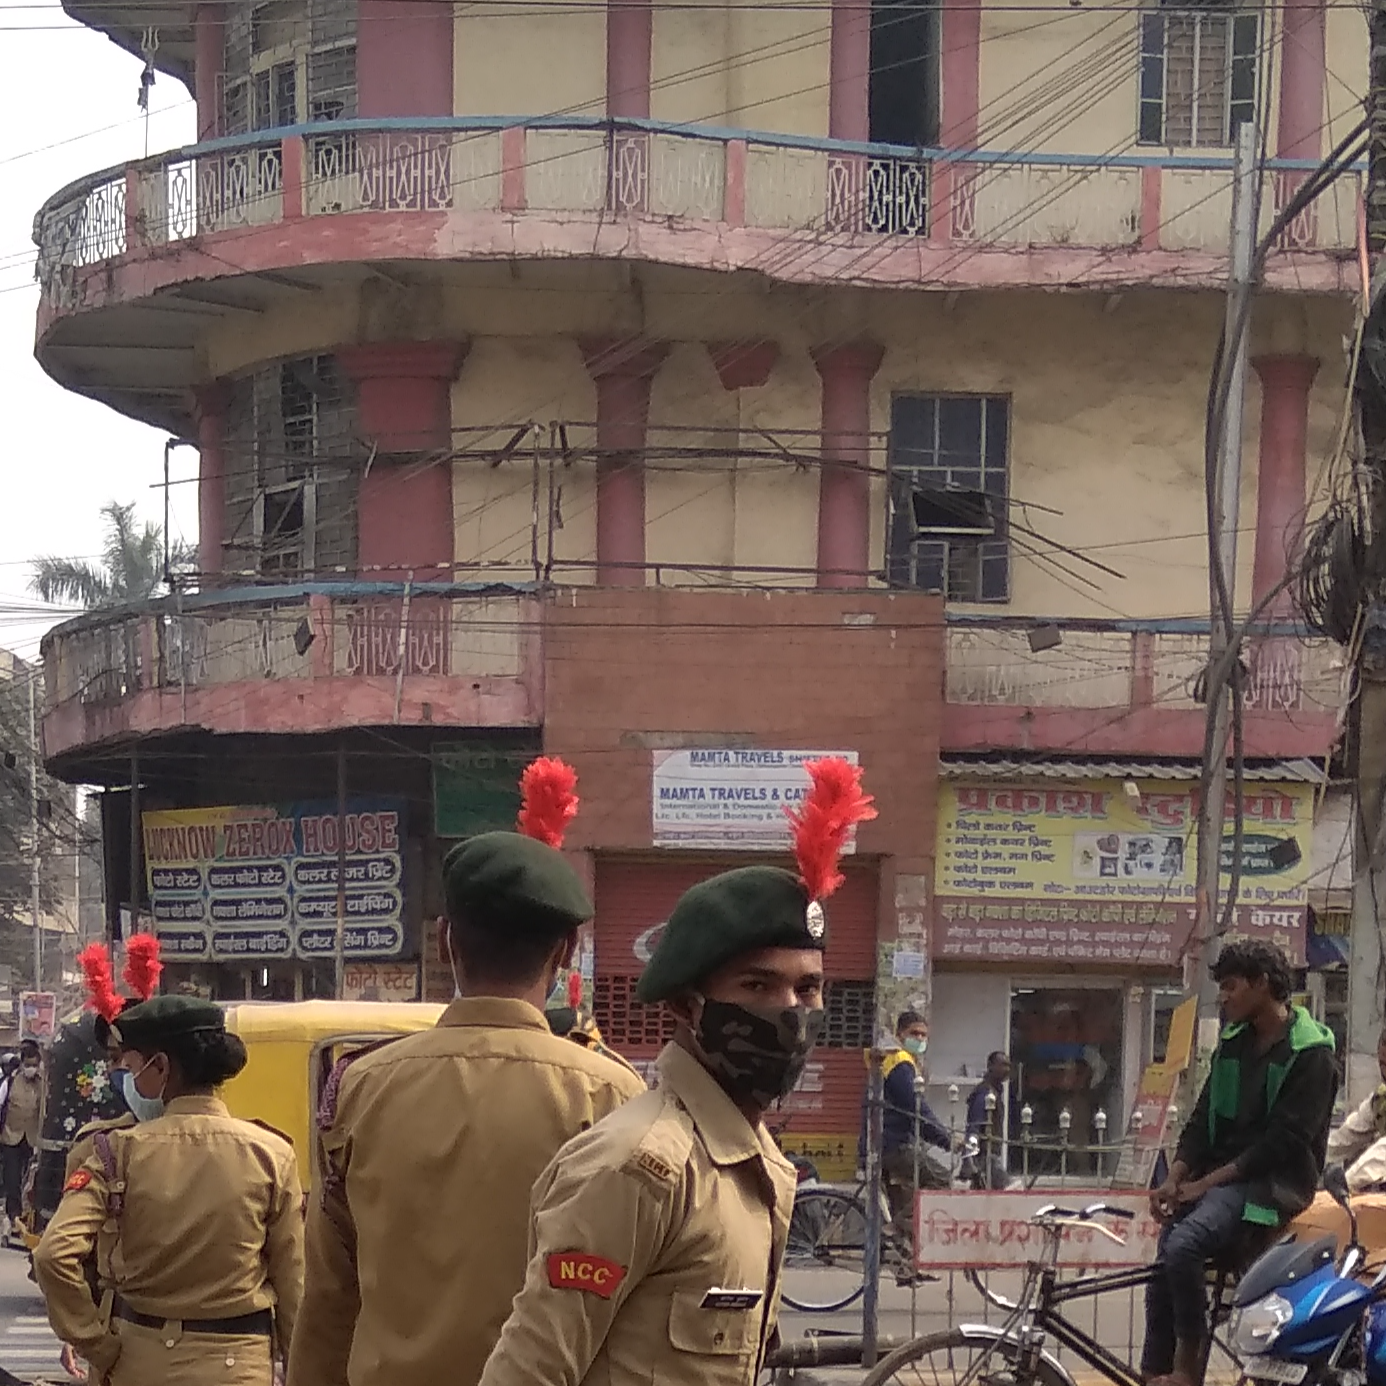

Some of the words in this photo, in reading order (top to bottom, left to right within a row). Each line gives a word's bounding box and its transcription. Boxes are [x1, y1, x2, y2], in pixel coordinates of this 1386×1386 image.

[689, 751, 730, 764] MAMTA
[733, 751, 784, 764] TRAVELS
[659, 787, 706, 801] MAMTA
[709, 787, 767, 801] TRAVELS
[771, 787, 781, 801] &
[955, 787, 1114, 820] प्रकाश
[723, 812, 763, 821] Booking
[144, 824, 216, 863] LUCKNOW
[222, 817, 296, 860] ZEROX
[300, 811, 400, 856] HOUSE
[297, 868, 328, 881] कलर
[297, 901, 338, 917] कम्प्यूट
[560, 1260, 613, 1285] NCC
